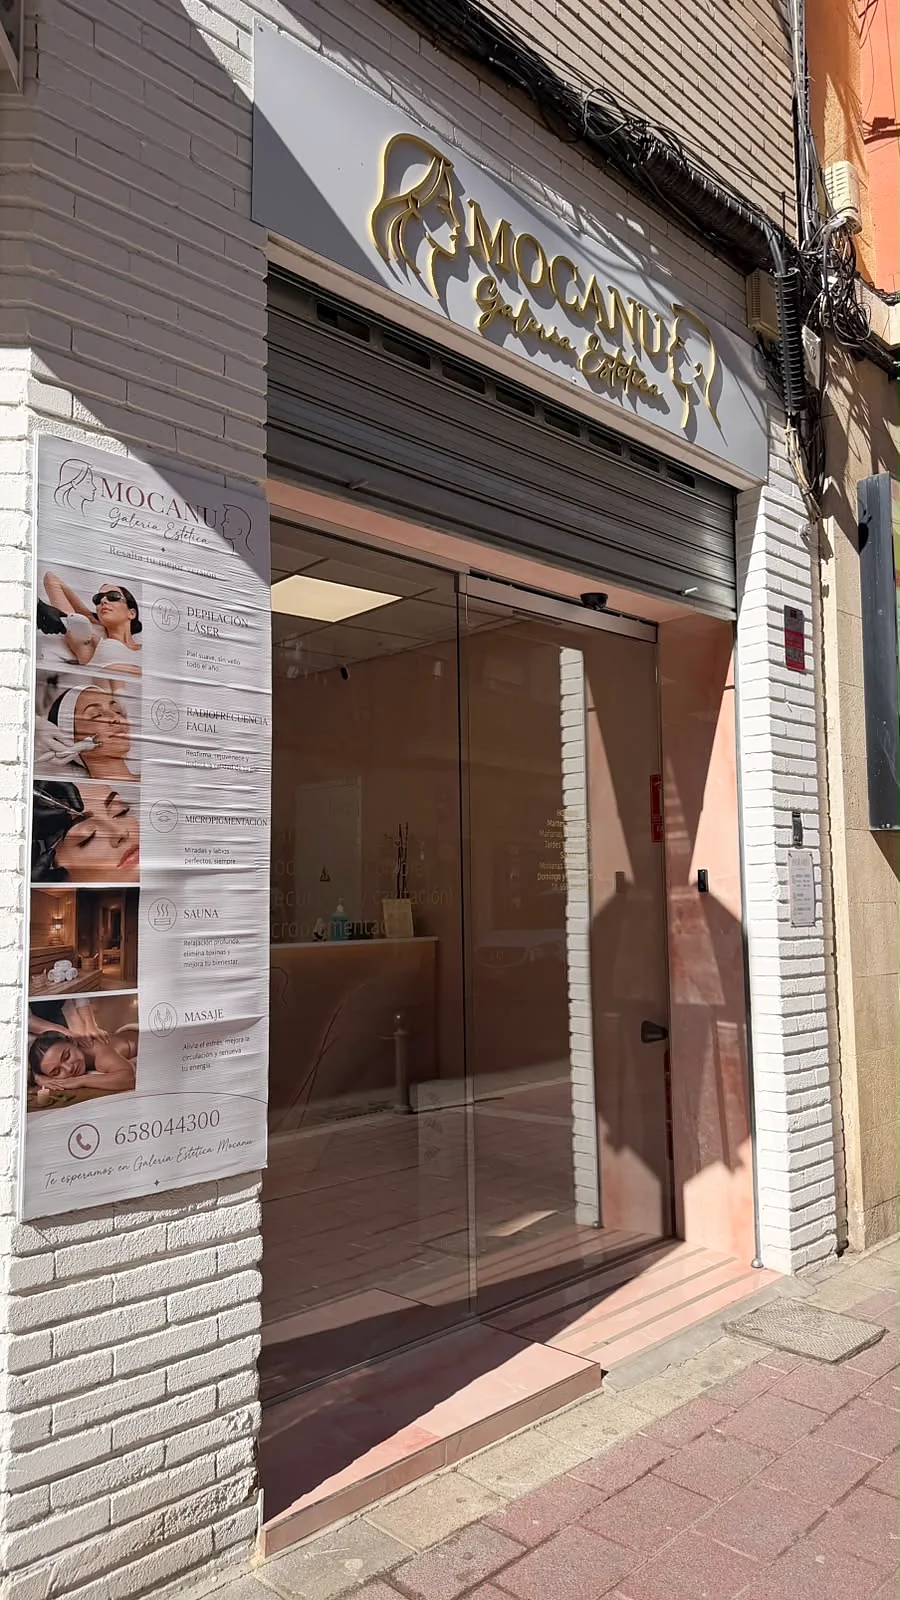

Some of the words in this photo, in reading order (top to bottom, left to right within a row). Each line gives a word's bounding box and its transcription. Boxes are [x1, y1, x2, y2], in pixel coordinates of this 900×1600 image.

[466, 199, 662, 357] MOCANU
[101, 478, 218, 529] MOCANU
[187, 606, 249, 628] DEPILACIÓN
[187, 621, 220, 637] LÁSER
[186, 707, 268, 726] RADIOFRECUENCIA
[186, 721, 219, 734] FACIAL
[183, 908, 219, 919] SAUNA
[184, 1008, 224, 1023] MASAJE
[114, 1109, 221, 1145] 658044300
[45, 1171, 58, 1189] Te
[60, 1166, 115, 1186] esperamos
[217, 1138, 256, 1154] Mocanu
